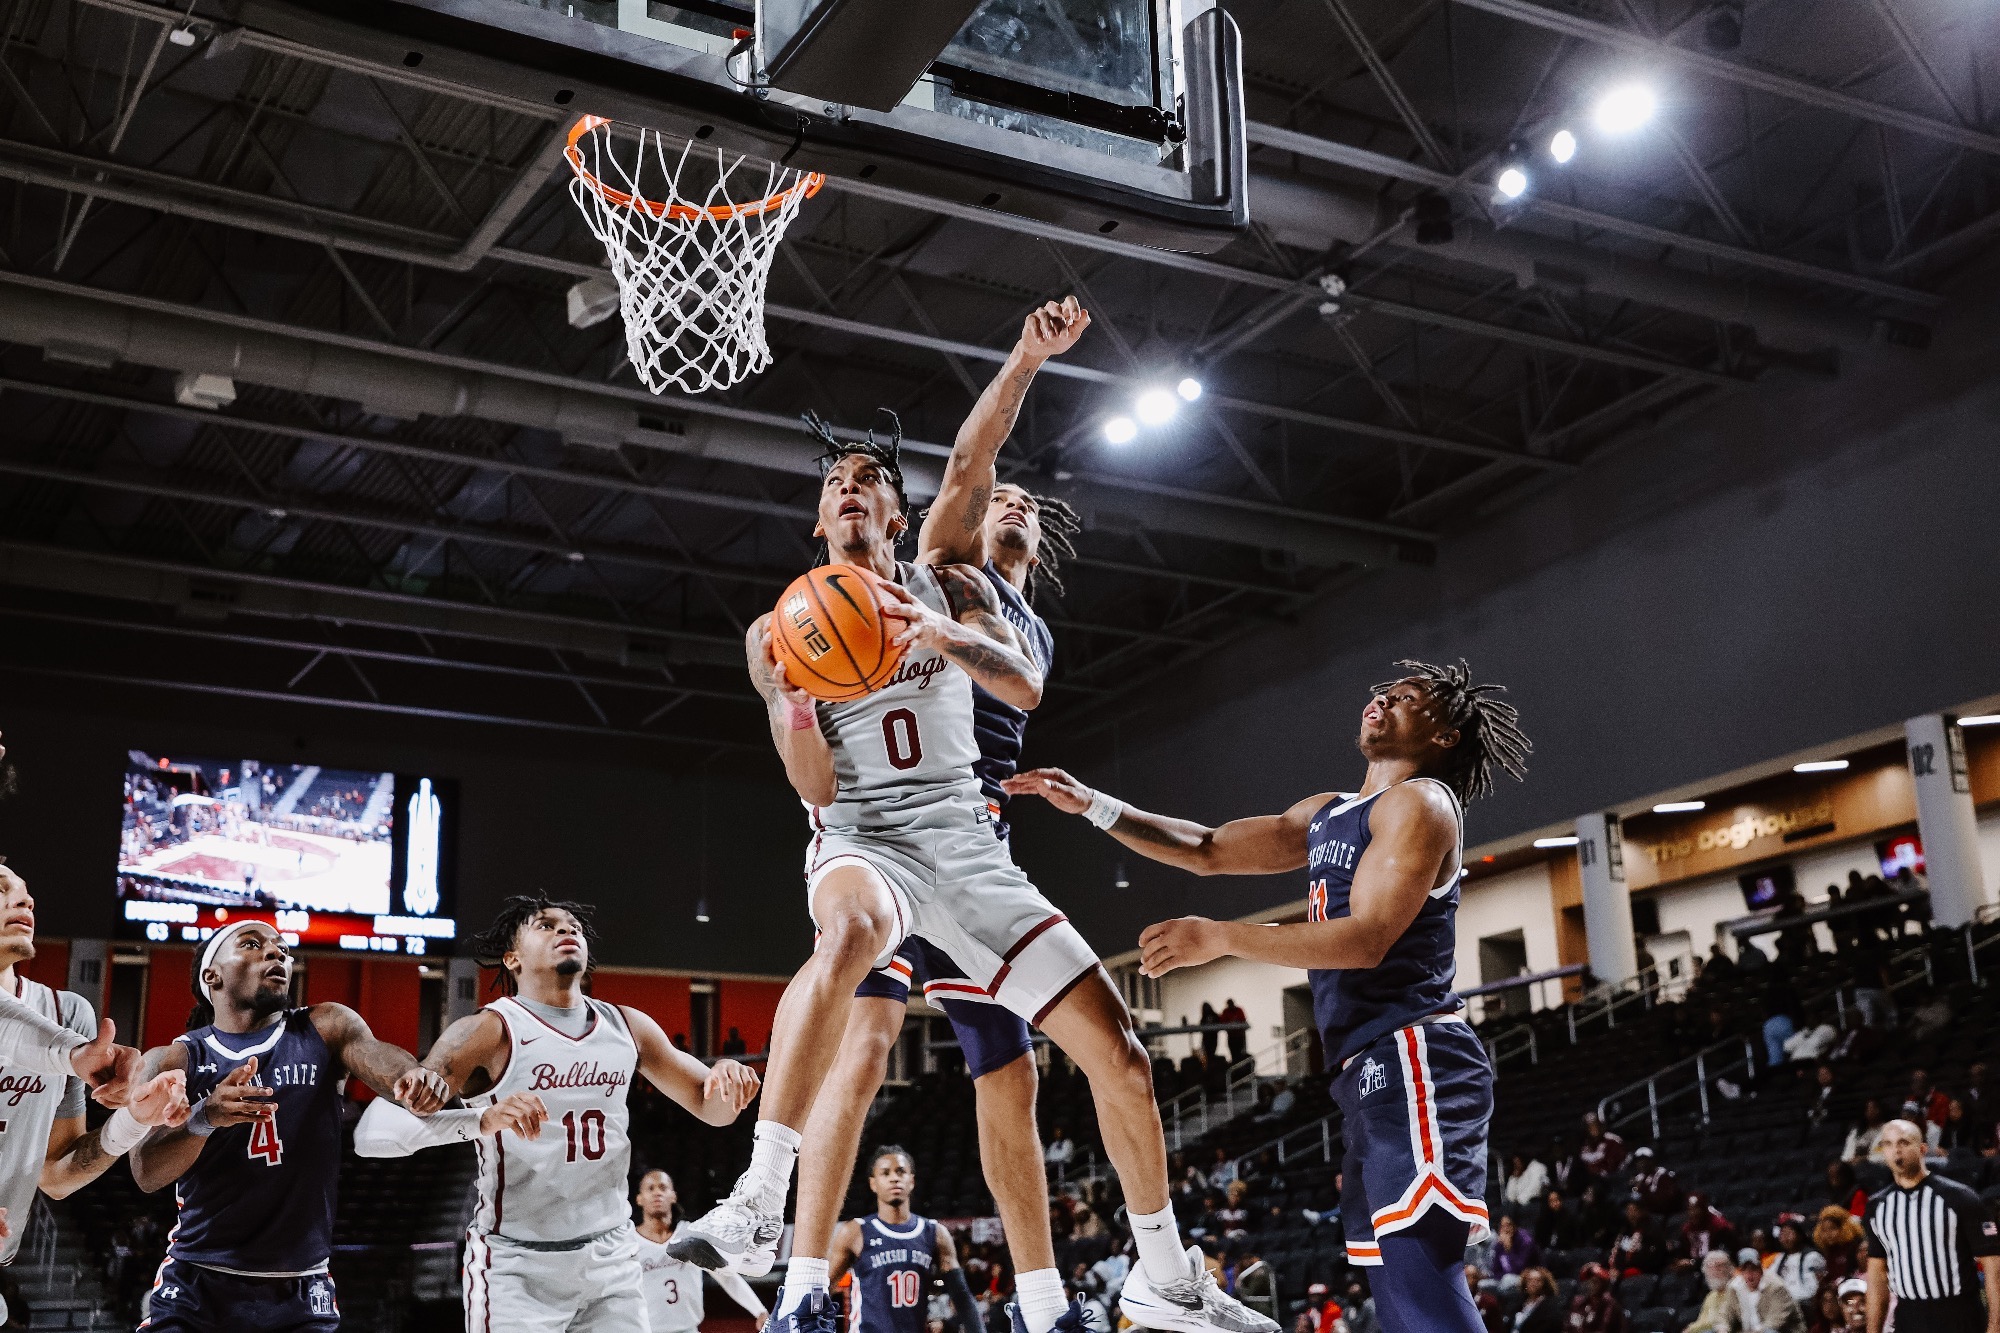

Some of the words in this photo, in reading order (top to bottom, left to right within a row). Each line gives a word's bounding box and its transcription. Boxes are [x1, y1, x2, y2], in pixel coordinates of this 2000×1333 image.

[785, 589, 833, 660] ELITE
[881, 706, 924, 771] 0
[274, 1063, 318, 1086] STATE
[528, 1061, 627, 1097] Bulldogs
[247, 1109, 284, 1167] 4
[561, 1109, 606, 1164] 10
[664, 1279, 679, 1304] 3
[886, 1270, 920, 1308] 10
